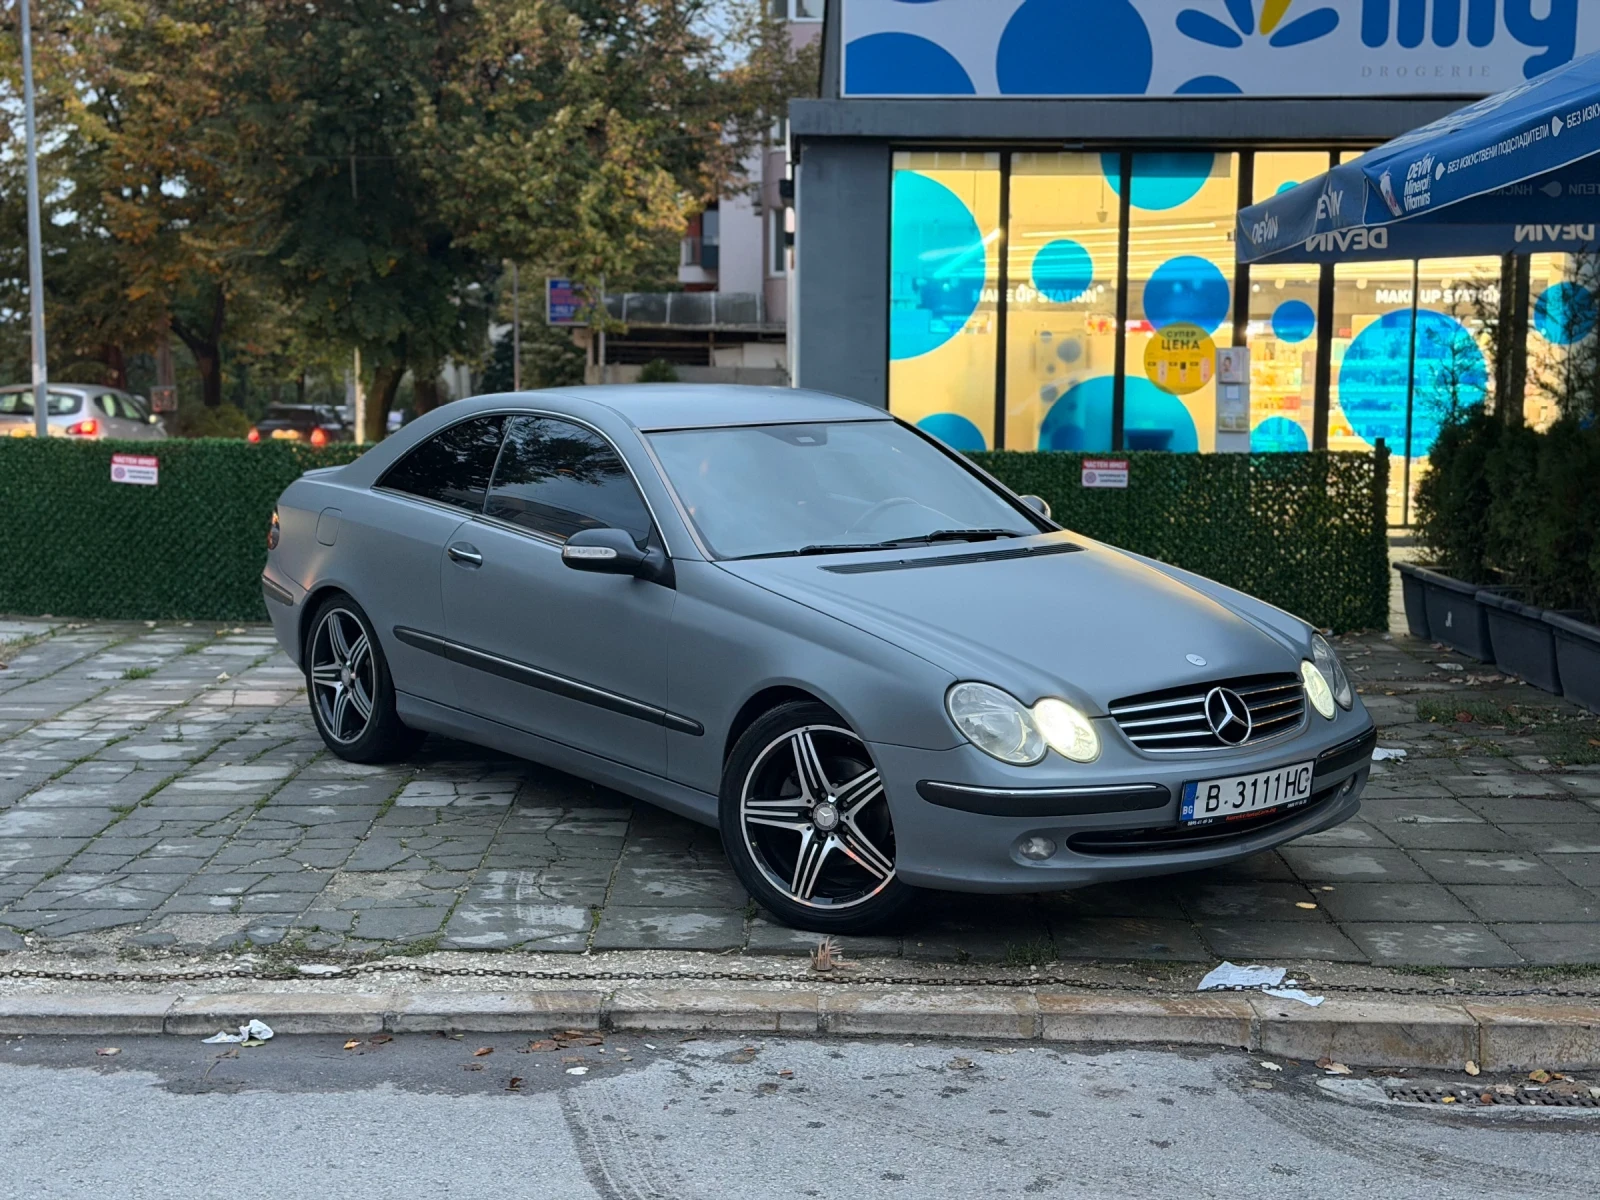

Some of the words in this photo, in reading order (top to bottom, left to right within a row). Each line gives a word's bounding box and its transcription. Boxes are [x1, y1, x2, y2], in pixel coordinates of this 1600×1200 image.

[1361, 65, 1491, 78] DROGERIE
[1566, 110, 1581, 128] БЕЗ
[1447, 159, 1460, 174] БЕЗ
[1498, 124, 1549, 155] ПОДСЛАДИТЕЛИ
[1407, 153, 1435, 180] DEVIN
[1404, 173, 1430, 196] Mineral
[1316, 184, 1344, 219] EVIN
[1404, 191, 1430, 211] Vitamins
[1252, 211, 1279, 244] DEVIN
[1375, 289, 1414, 304] MAK
[1420, 289, 1441, 303] UP
[1166, 330, 1197, 338] СУПЕР
[1161, 339, 1201, 351] ЦЕНА
[1182, 805, 1194, 815] BG
